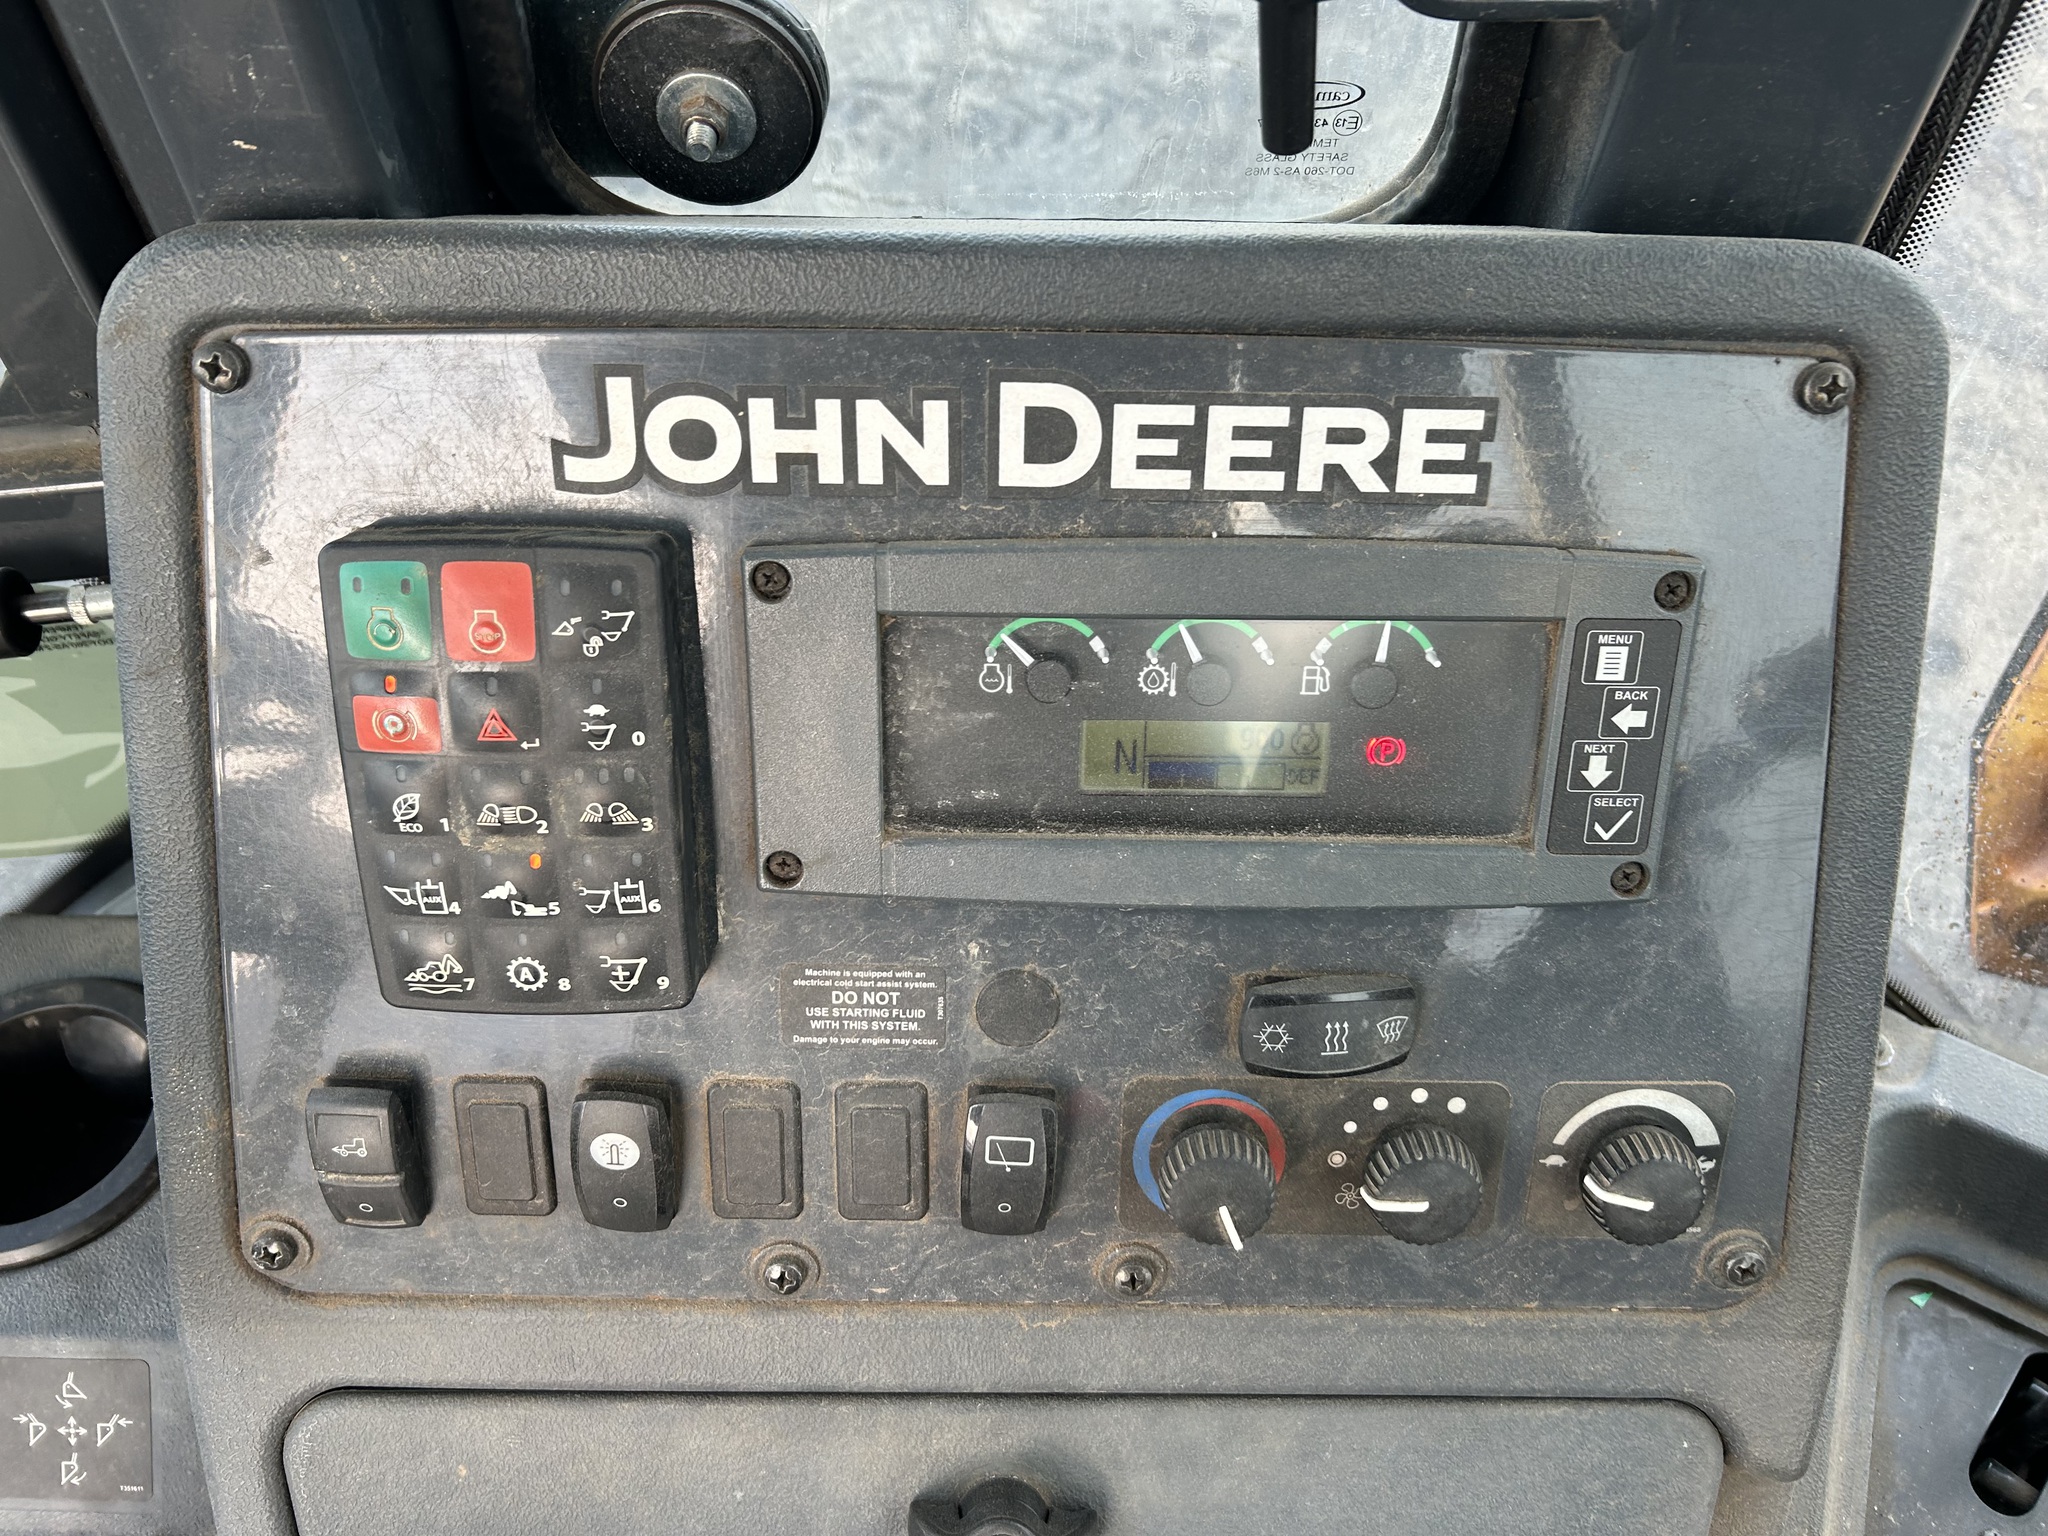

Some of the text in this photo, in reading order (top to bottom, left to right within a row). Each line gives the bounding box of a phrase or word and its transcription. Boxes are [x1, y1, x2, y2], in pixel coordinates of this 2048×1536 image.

[562, 375, 1486, 495] JOHN DEERE
[1598, 634, 1633, 645] MENU
[1614, 690, 1649, 701] BACK
[1241, 726, 1285, 751] 90
[1584, 744, 1616, 754] NEXT
[1115, 738, 1138, 775] N
[1287, 768, 1319, 786] DEF
[1593, 797, 1639, 807] SELECT
[398, 822, 424, 833] ECO
[439, 818, 450, 832] 1
[536, 820, 549, 834] 2
[641, 818, 654, 832] 3
[422, 893, 443, 904] AUX
[620, 894, 642, 904] AUX
[448, 901, 461, 915] 4
[548, 901, 561, 915] 5
[647, 899, 662, 913] 6
[520, 967, 534, 981] A
[804, 968, 926, 979] Machine is equipped with an
[463, 978, 475, 991] 7
[558, 978, 572, 991] 8
[656, 976, 670, 990] 9
[793, 979, 938, 990] electrical cold start assist system.
[831, 991, 901, 1006] DO NOT
[806, 1007, 926, 1019] USE STARTING FLUID
[810, 1020, 921, 1031] WITH THIS SYSTEM.
[793, 1035, 939, 1046] Damage to your engine may occur.
